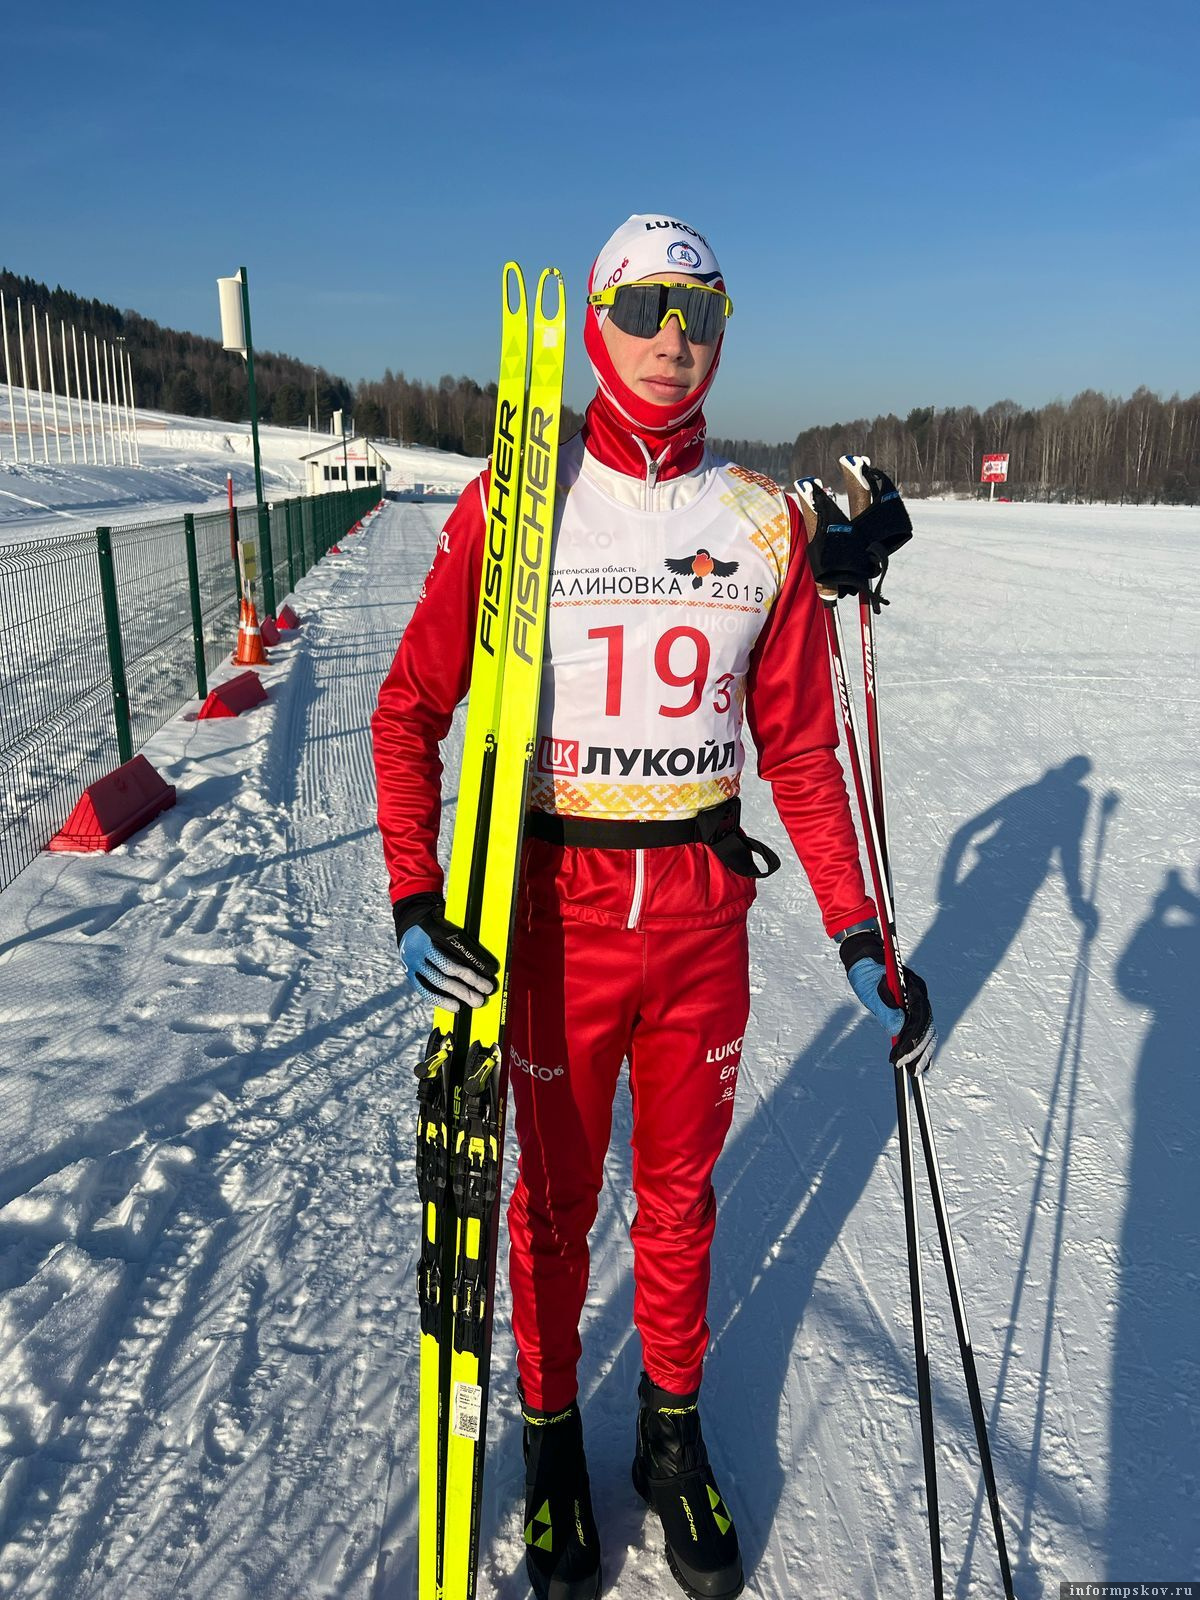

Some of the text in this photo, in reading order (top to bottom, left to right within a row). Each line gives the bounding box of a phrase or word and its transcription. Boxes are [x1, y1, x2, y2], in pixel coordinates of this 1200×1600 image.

[480, 399, 518, 657] FISCHER
[512, 406, 554, 665] FISCHER
[551, 576, 764, 603] АЛИНОВКА 2015
[602, 564, 637, 574] область
[588, 624, 735, 718] 19 3
[581, 739, 735, 777] ЛУКОЙЛ
[679, 1495, 698, 1541] FISCHER
